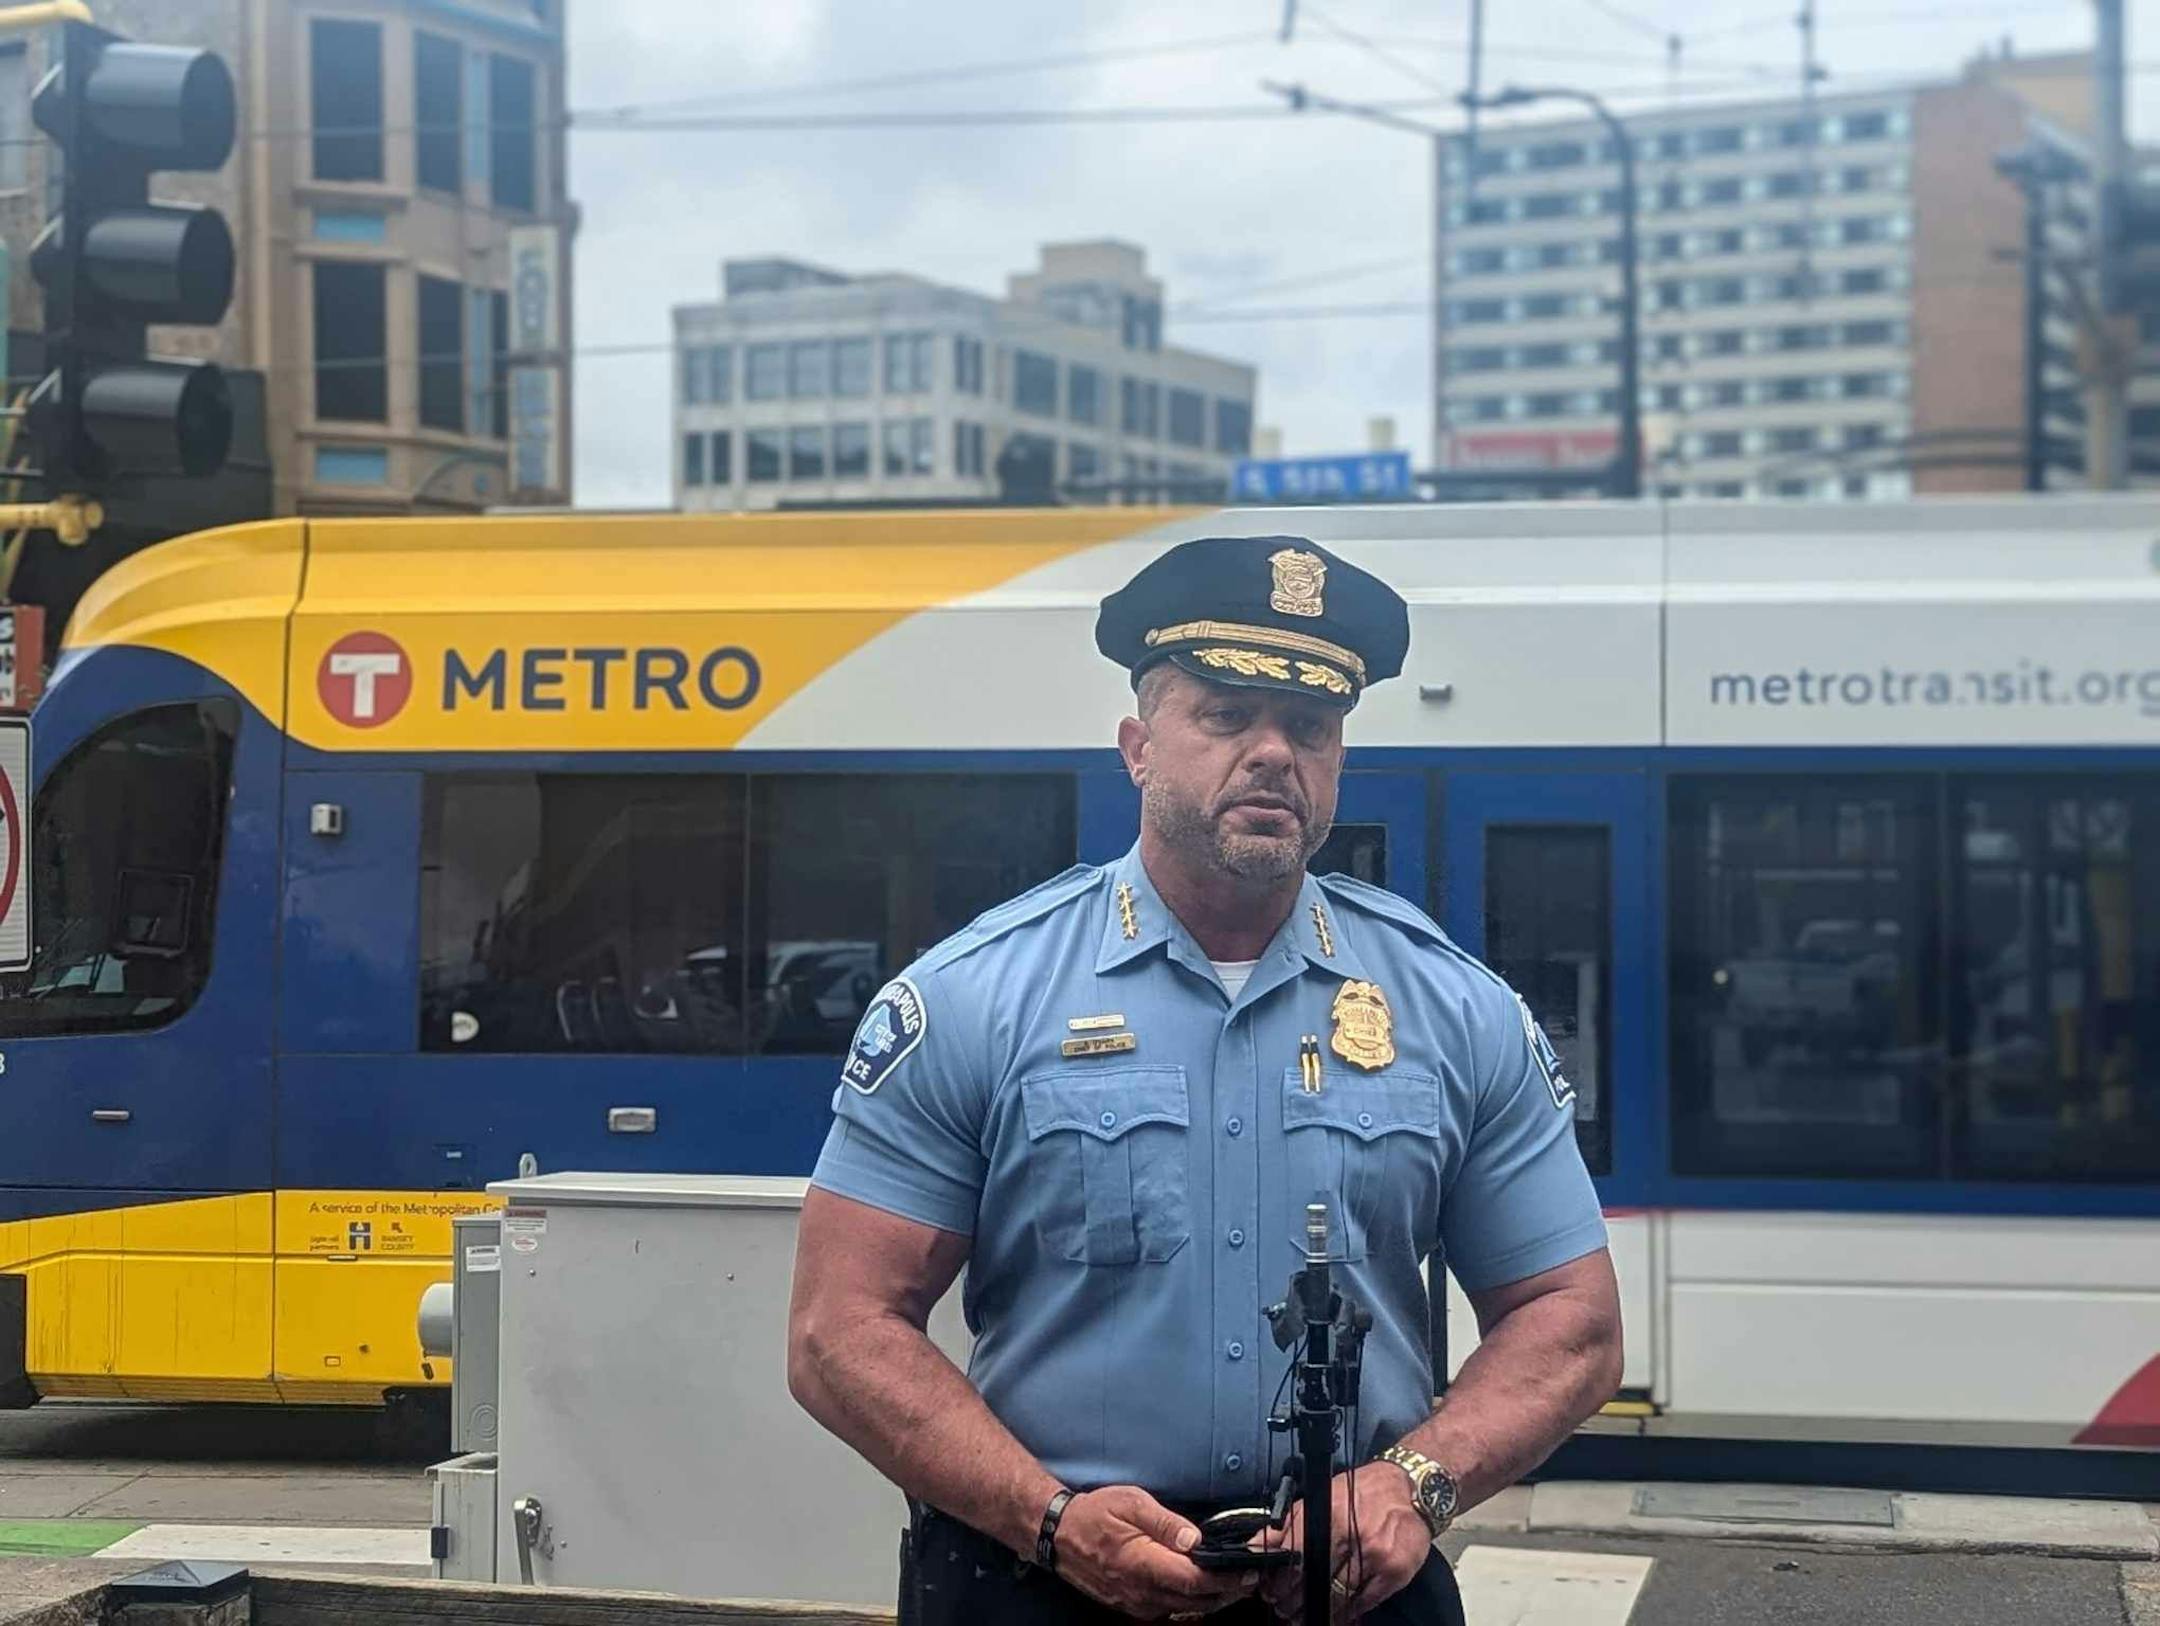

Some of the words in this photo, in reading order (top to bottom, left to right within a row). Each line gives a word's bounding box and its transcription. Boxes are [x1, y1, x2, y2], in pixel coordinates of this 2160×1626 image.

[330, 653, 400, 717] T
[442, 646, 761, 711] METRO
[1710, 657, 2160, 718] metrotransit.org
[309, 1202, 320, 1213] A
[322, 1202, 362, 1214] service
[366, 1201, 378, 1214] of
[381, 1202, 401, 1214] the
[403, 1203, 480, 1218] Metropolitan
